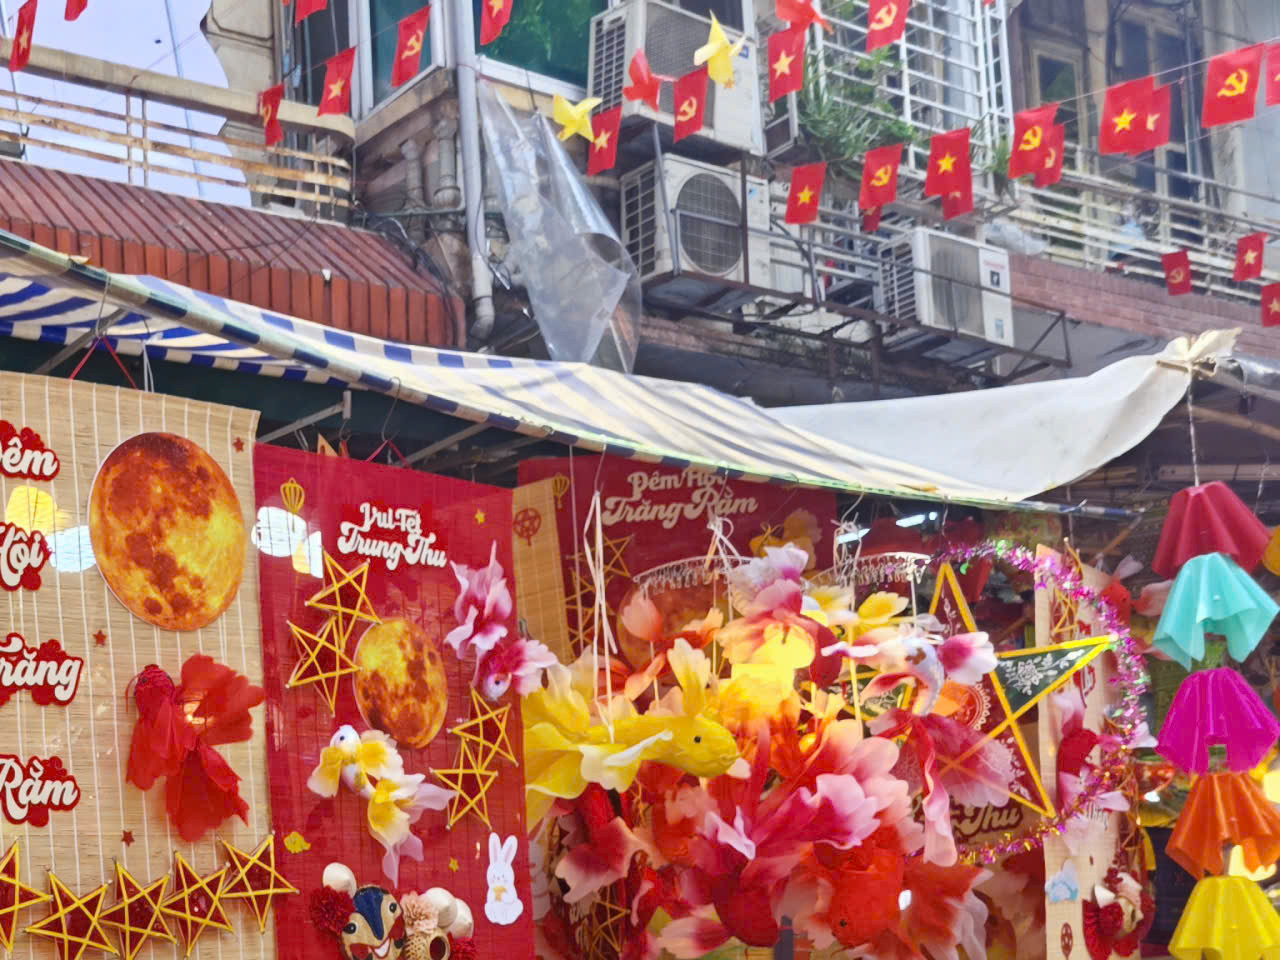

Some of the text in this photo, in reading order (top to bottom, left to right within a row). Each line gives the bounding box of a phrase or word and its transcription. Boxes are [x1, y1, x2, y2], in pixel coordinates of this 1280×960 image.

[601, 486, 759, 529] Trăng Rằm
[337, 521, 447, 571] Trung Thu
